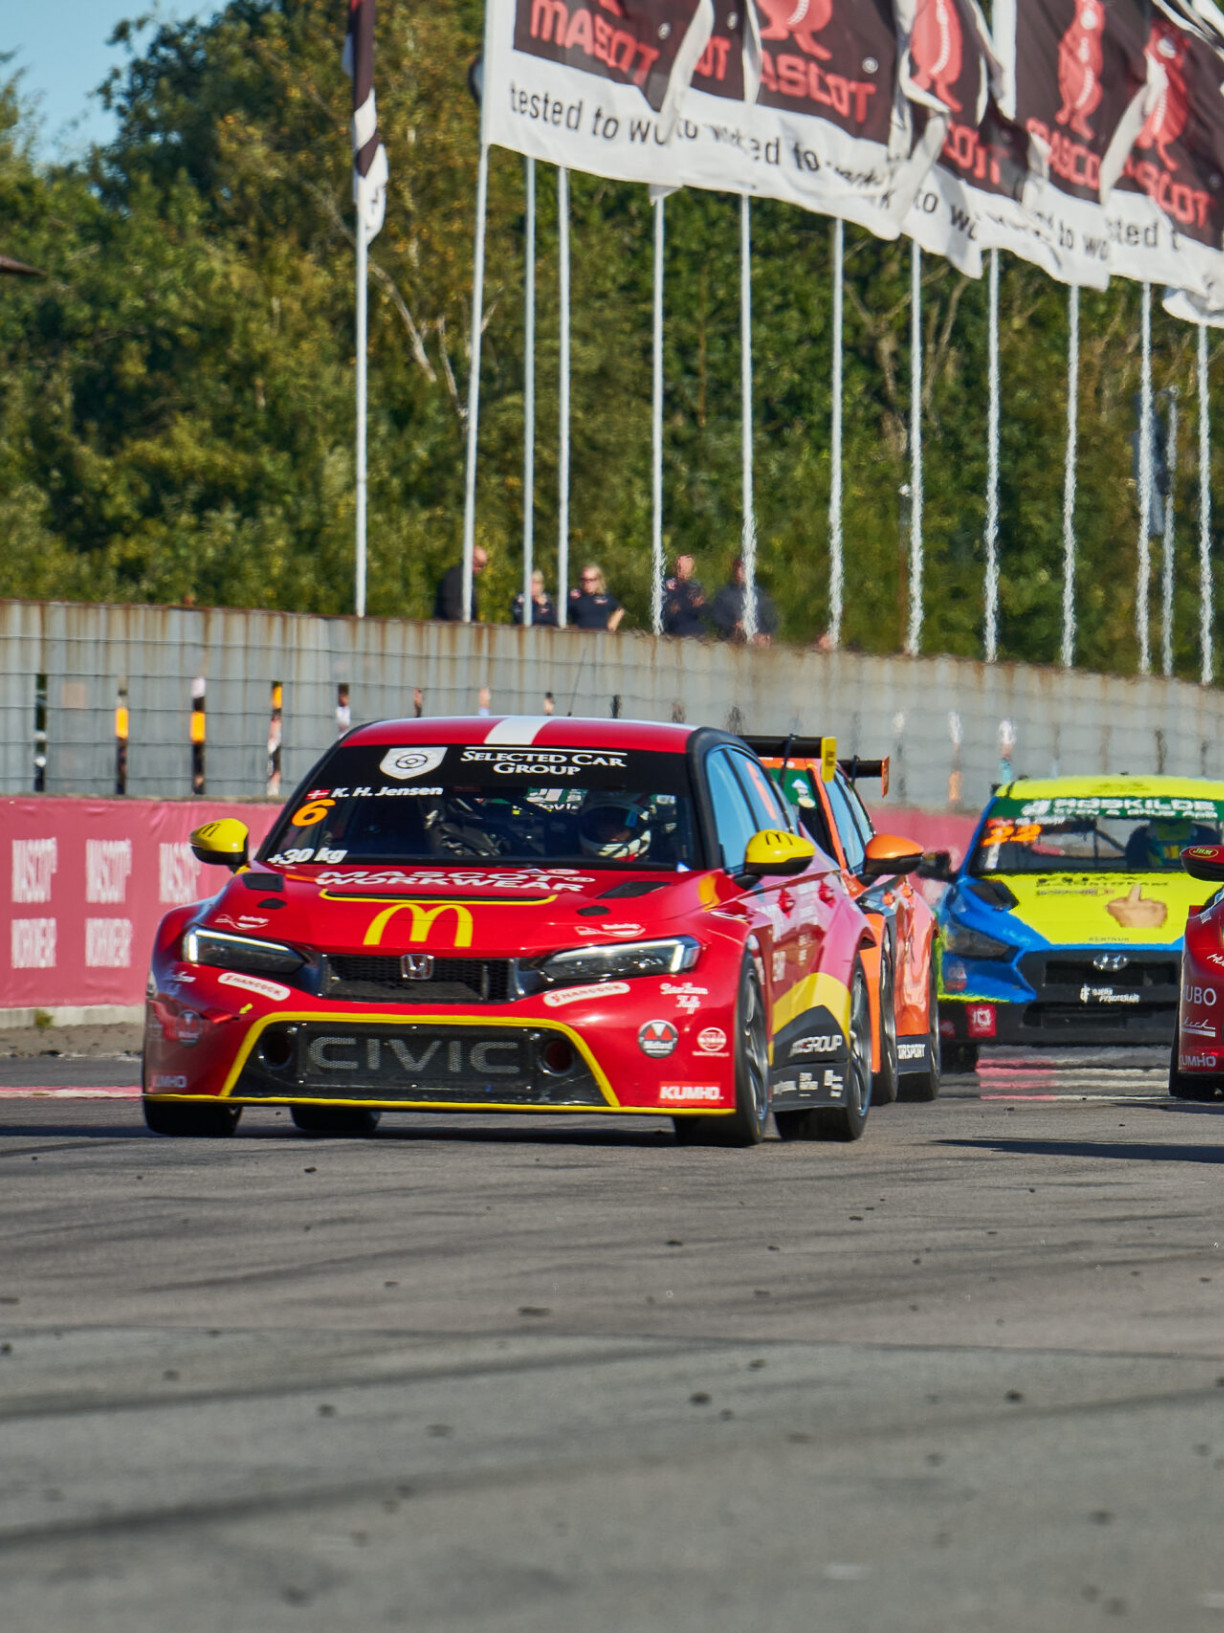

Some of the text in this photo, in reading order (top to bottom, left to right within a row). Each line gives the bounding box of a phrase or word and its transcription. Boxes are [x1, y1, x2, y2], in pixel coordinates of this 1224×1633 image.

[530, 0, 660, 86] MASOT
[759, 48, 877, 124] ASCOT
[510, 81, 583, 131] tested
[592, 107, 619, 140] to
[460, 750, 627, 768] SELECTED CAR
[492, 762, 582, 776] GROUP
[331, 786, 444, 798] K. H. Jensen
[291, 798, 337, 827] 6
[313, 847, 349, 865] kg
[315, 877, 585, 892] WORKWEAR
[1183, 987, 1217, 1007] UBO
[308, 1036, 521, 1074] CIVIC
[150, 1074, 187, 1089] UMHO
[660, 1085, 720, 1100] KUMHO
